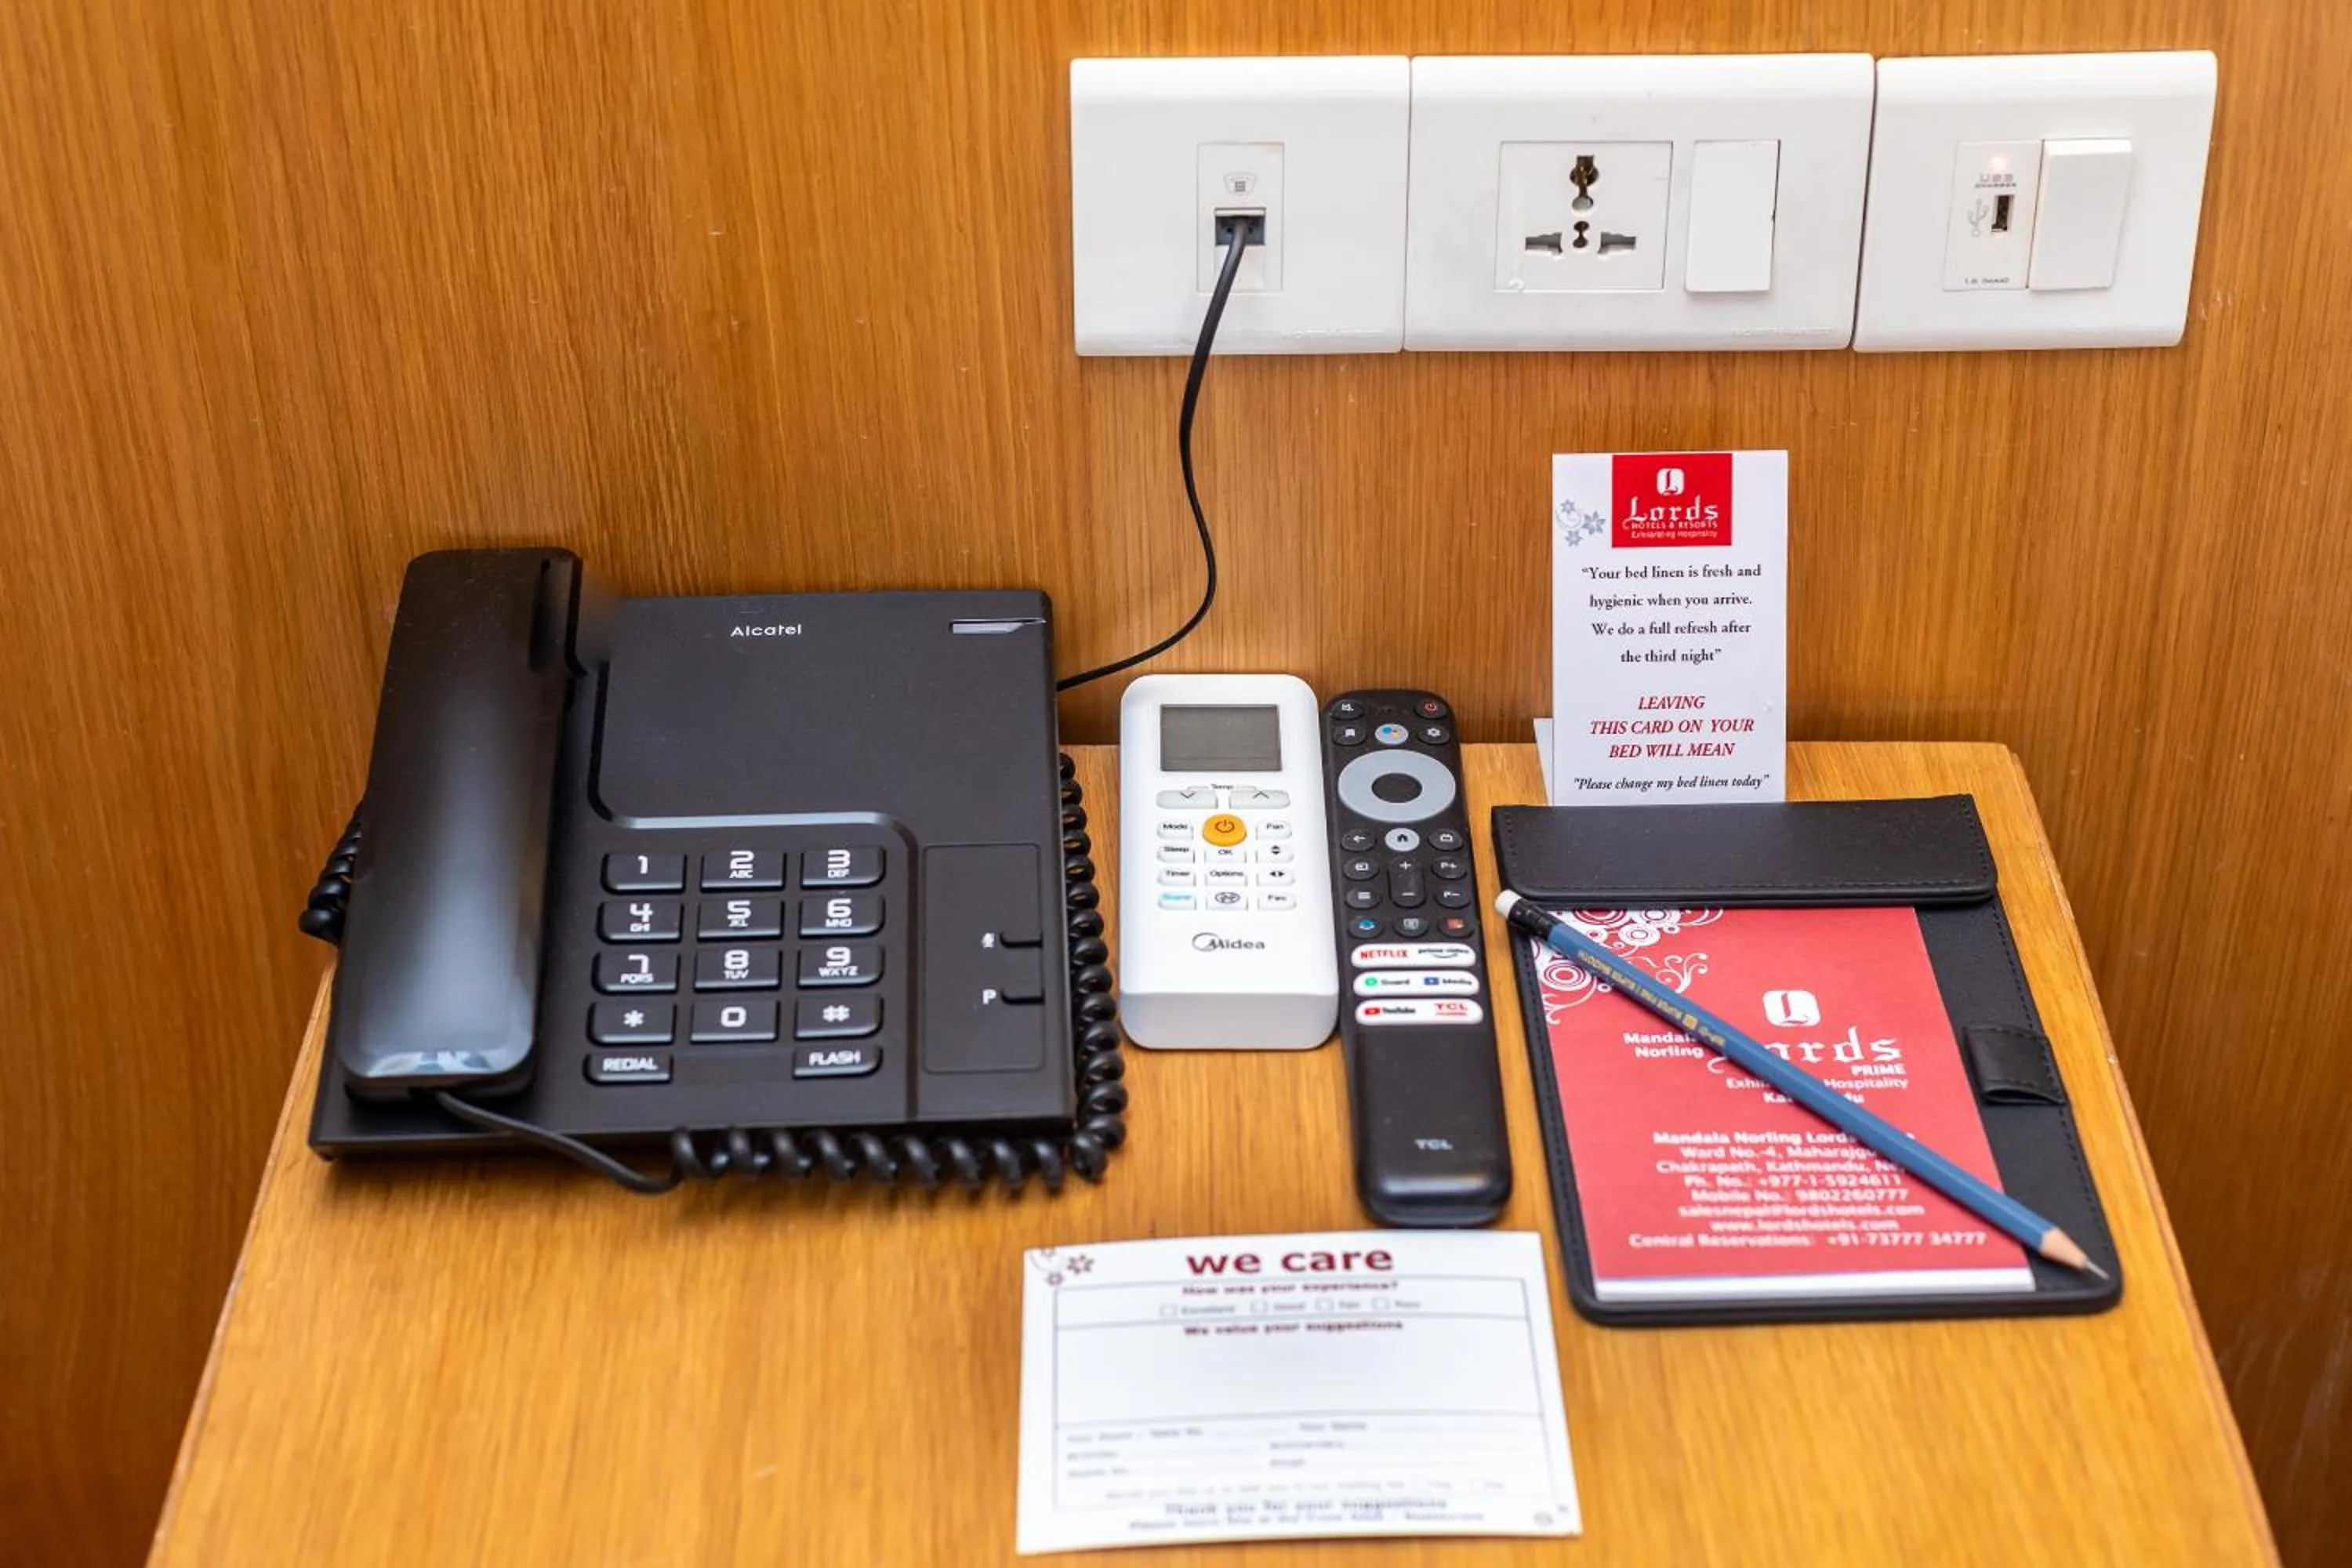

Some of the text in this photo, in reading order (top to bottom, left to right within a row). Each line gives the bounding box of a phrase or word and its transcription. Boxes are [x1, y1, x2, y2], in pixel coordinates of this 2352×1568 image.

[1630, 495, 1719, 521] Lords
[1631, 521, 1666, 529] HOTELS
[1678, 521, 1718, 529] RESORTS
[1624, 566, 1647, 579] bed
[1652, 566, 1684, 579] linen
[1688, 565, 1699, 578] is
[1702, 564, 1733, 578] fresh
[1737, 564, 1762, 577] and
[1589, 593, 1753, 610] hygienic when you arrive.
[731, 623, 803, 637] Alcatel
[1592, 620, 1751, 636] We do a full refresh after
[1621, 650, 1642, 663] the
[1645, 649, 1676, 662] third
[1638, 695, 1707, 710] LEAVING
[1590, 719, 1755, 735] THIS CARD ON YOUR
[1609, 742, 1736, 758] BED WILL MEAN
[1614, 775, 1653, 793] change
[1657, 779, 1675, 791] my
[1677, 775, 1698, 789] bed
[1700, 775, 1729, 789] linen
[637, 855, 649, 874] 1
[730, 850, 755, 870] 2
[827, 849, 851, 869] 3
[729, 870, 753, 879] ABC
[827, 869, 849, 878] DEF
[630, 902, 653, 923] 4
[727, 900, 752, 920] 5
[826, 898, 852, 918] 6
[630, 923, 651, 932] GHI
[826, 918, 852, 928] MNO
[1200, 934, 1265, 951] Midea
[724, 949, 750, 970] 8
[826, 946, 851, 967] 9
[1360, 949, 1408, 960] NETFLIX
[628, 953, 650, 974] 7
[723, 969, 750, 980] TUV
[818, 966, 859, 978] WXYZ
[982, 989, 996, 1005] P
[1382, 1006, 1416, 1014] YouTube
[1434, 1003, 1468, 1011] TCL
[1623, 1032, 1698, 1045] Manda
[1760, 1025, 1903, 1064] ords
[808, 1051, 861, 1066] FLASH
[1635, 1045, 1704, 1059] Norling
[602, 1057, 659, 1072] REDIAL
[1851, 1064, 1906, 1076] PRIME
[1823, 1077, 1908, 1089] Hospitality
[1414, 1138, 1454, 1150] TCL
[1653, 1131, 1730, 1144] Mandala
[1733, 1131, 1803, 1145] Norling
[1680, 1146, 1726, 1158] Ward
[1786, 1145, 1876, 1160] Maharajg
[1766, 1160, 1871, 1173] Kathmandu,
[1690, 1189, 1751, 1202] Mobile
[1709, 1219, 1900, 1232] www.lordshotels.com
[1628, 1233, 1695, 1247] Central
[1187, 1250, 1394, 1274] we care
